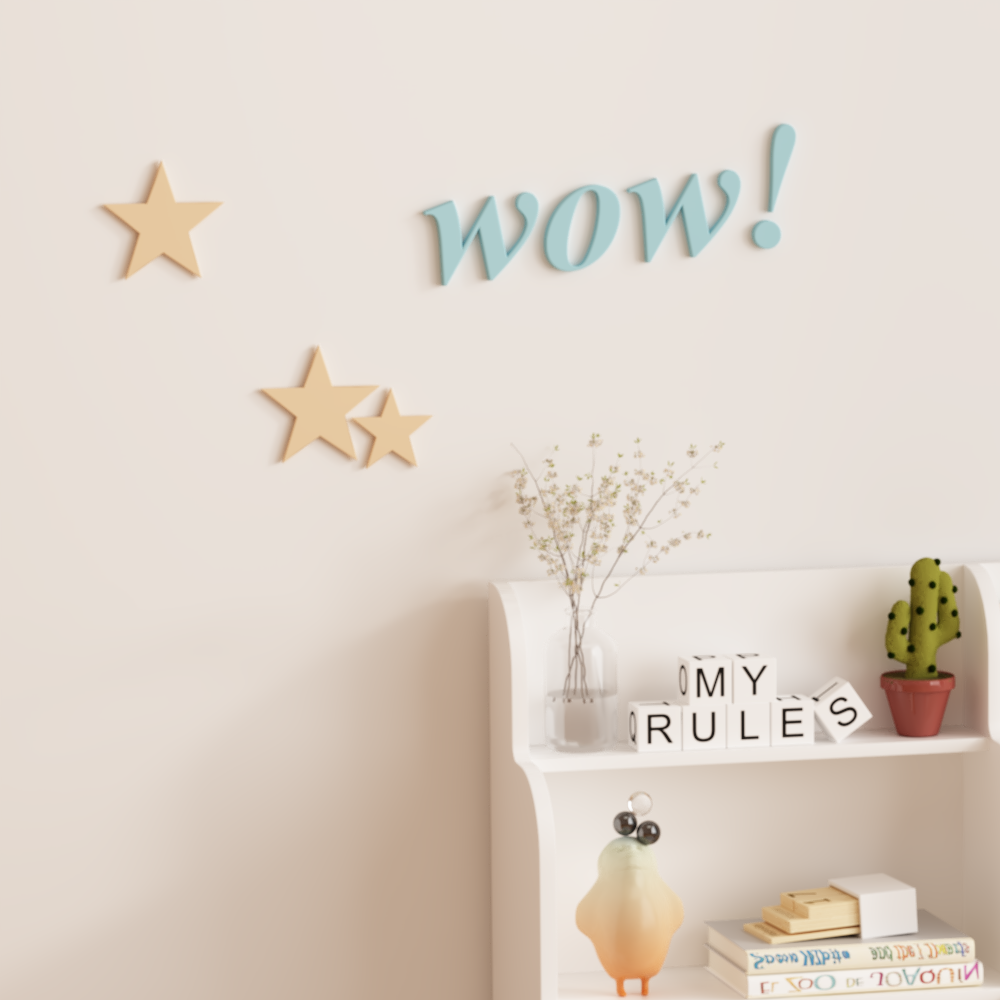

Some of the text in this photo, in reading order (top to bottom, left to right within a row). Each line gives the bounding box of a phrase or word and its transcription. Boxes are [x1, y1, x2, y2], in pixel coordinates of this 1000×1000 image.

[423, 123, 798, 287] wow!
[696, 665, 767, 698] MY
[647, 696, 858, 745] RULES
